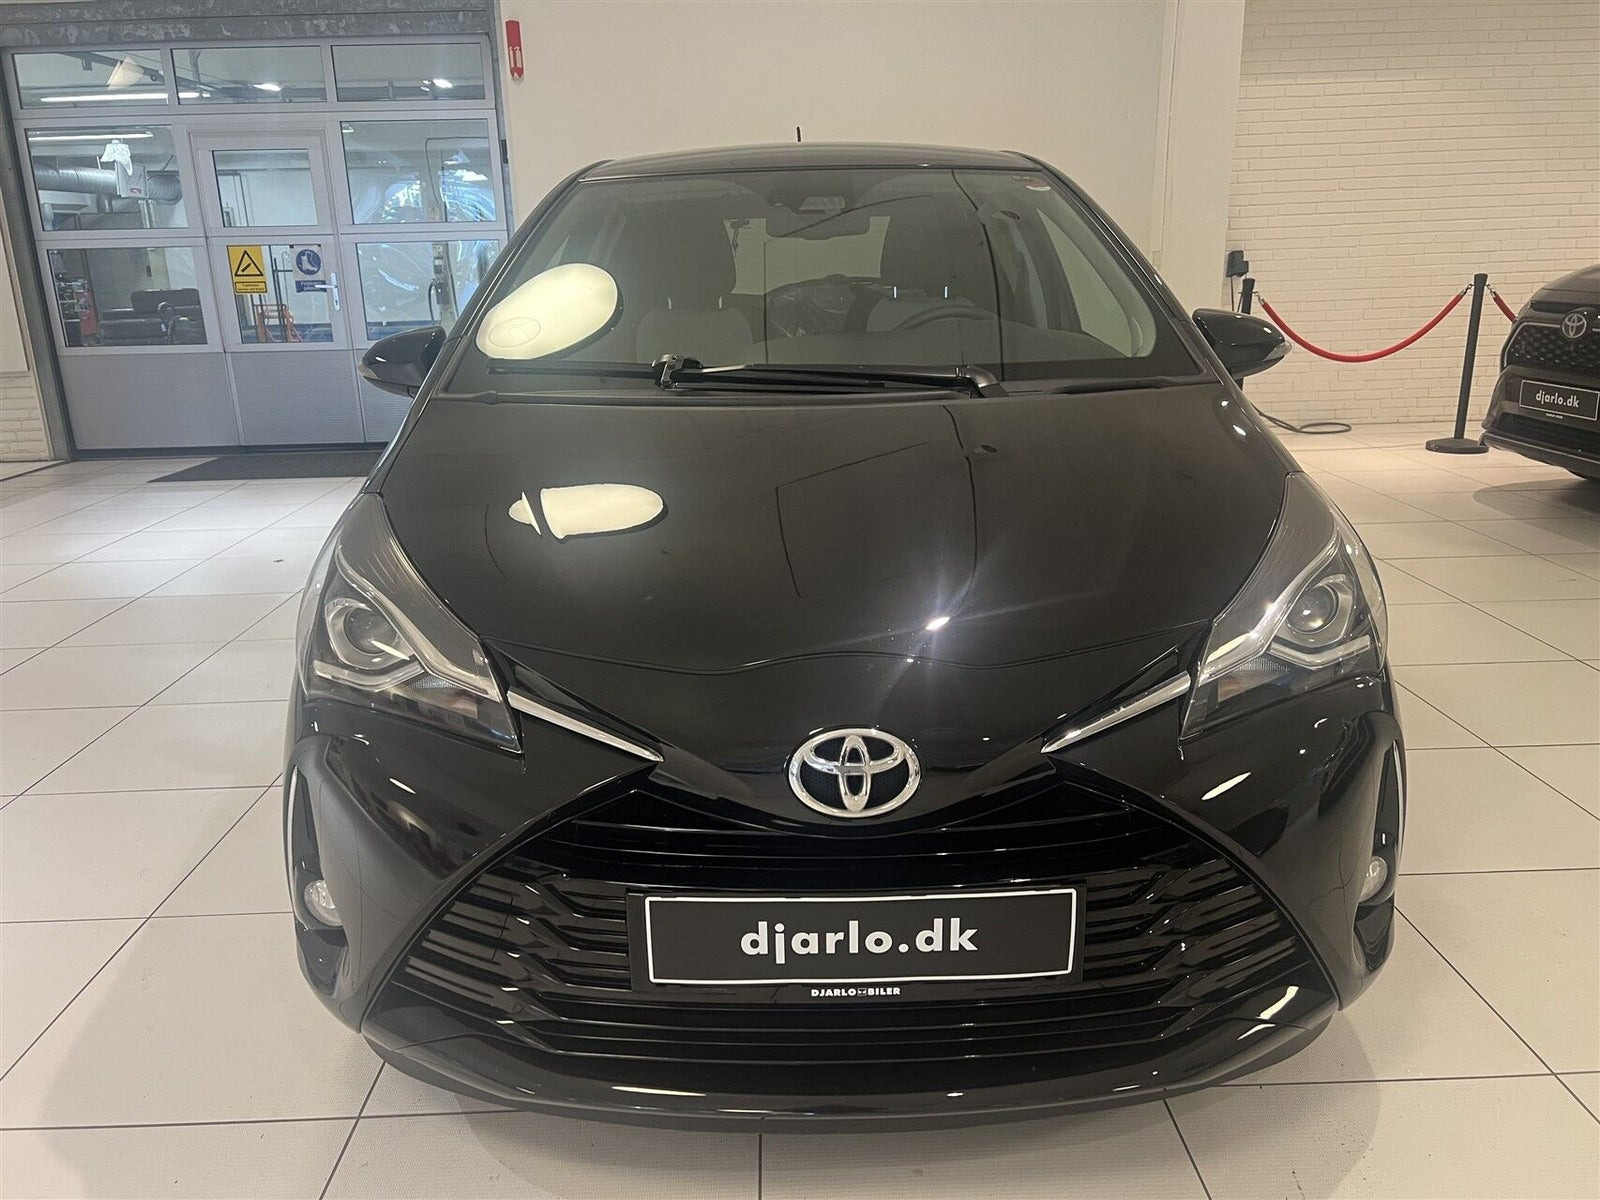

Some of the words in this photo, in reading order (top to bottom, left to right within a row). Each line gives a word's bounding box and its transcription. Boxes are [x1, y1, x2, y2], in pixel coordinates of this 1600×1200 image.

[1535, 389, 1580, 408] djarlo.dk
[740, 917, 979, 965] djarlo.dk
[810, 988, 857, 997] DJARLO
[867, 987, 901, 996] BILER
